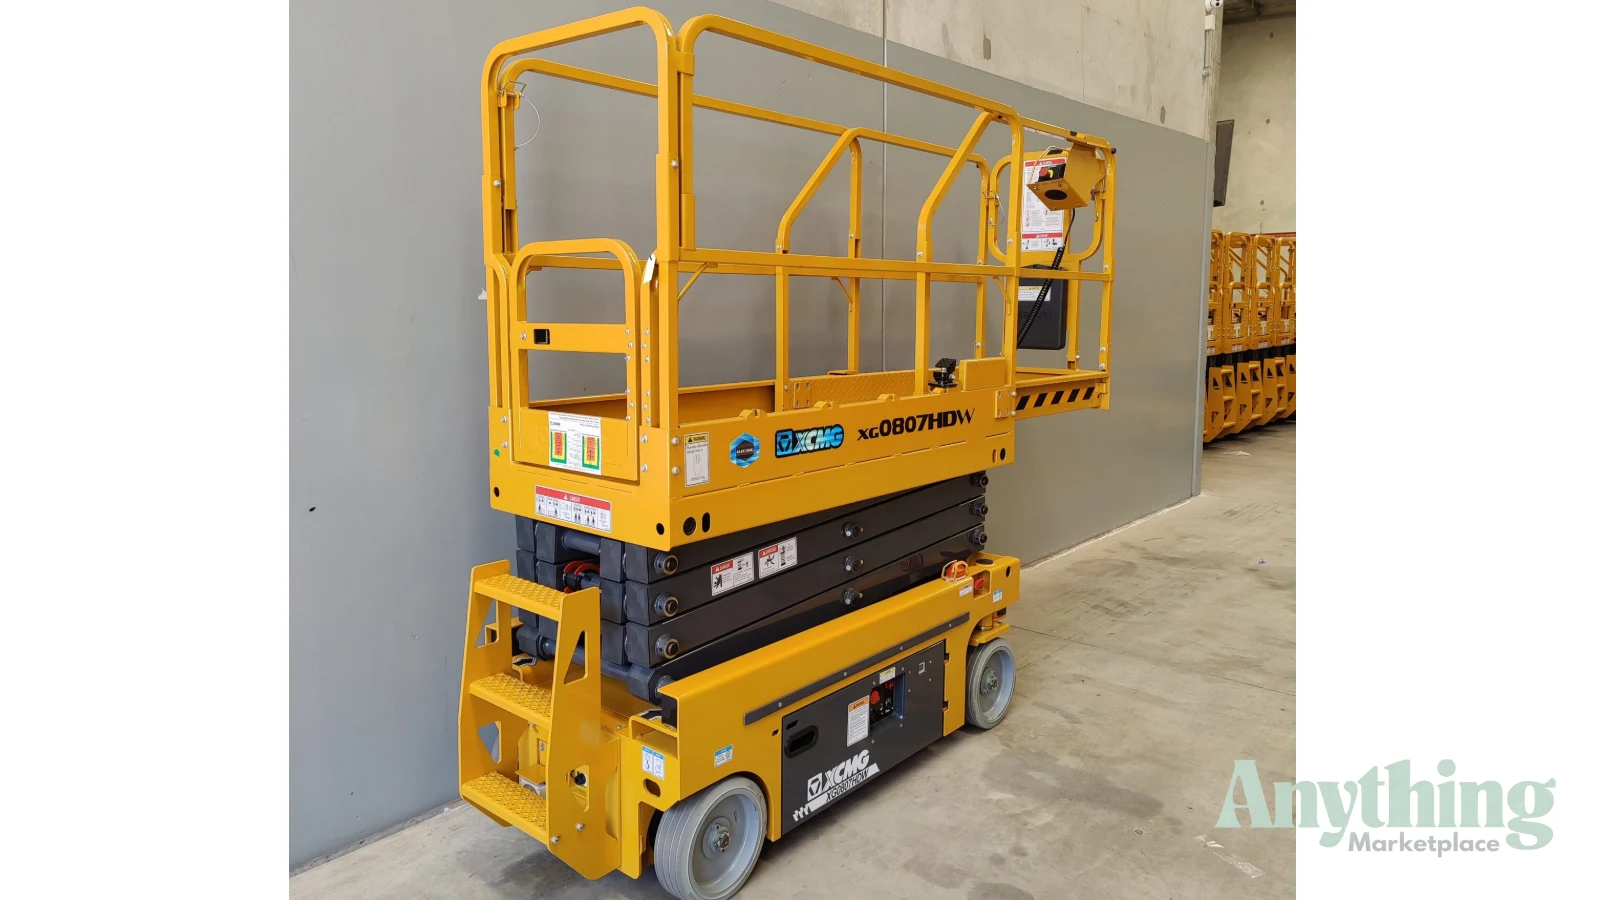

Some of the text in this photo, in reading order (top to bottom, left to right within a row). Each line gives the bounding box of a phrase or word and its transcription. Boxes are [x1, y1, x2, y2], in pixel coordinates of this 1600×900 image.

[791, 425, 844, 454] XCMG
[857, 407, 976, 441] XG0807HDW
[822, 749, 870, 793] XCMG
[826, 768, 870, 803] XG0807HDW
